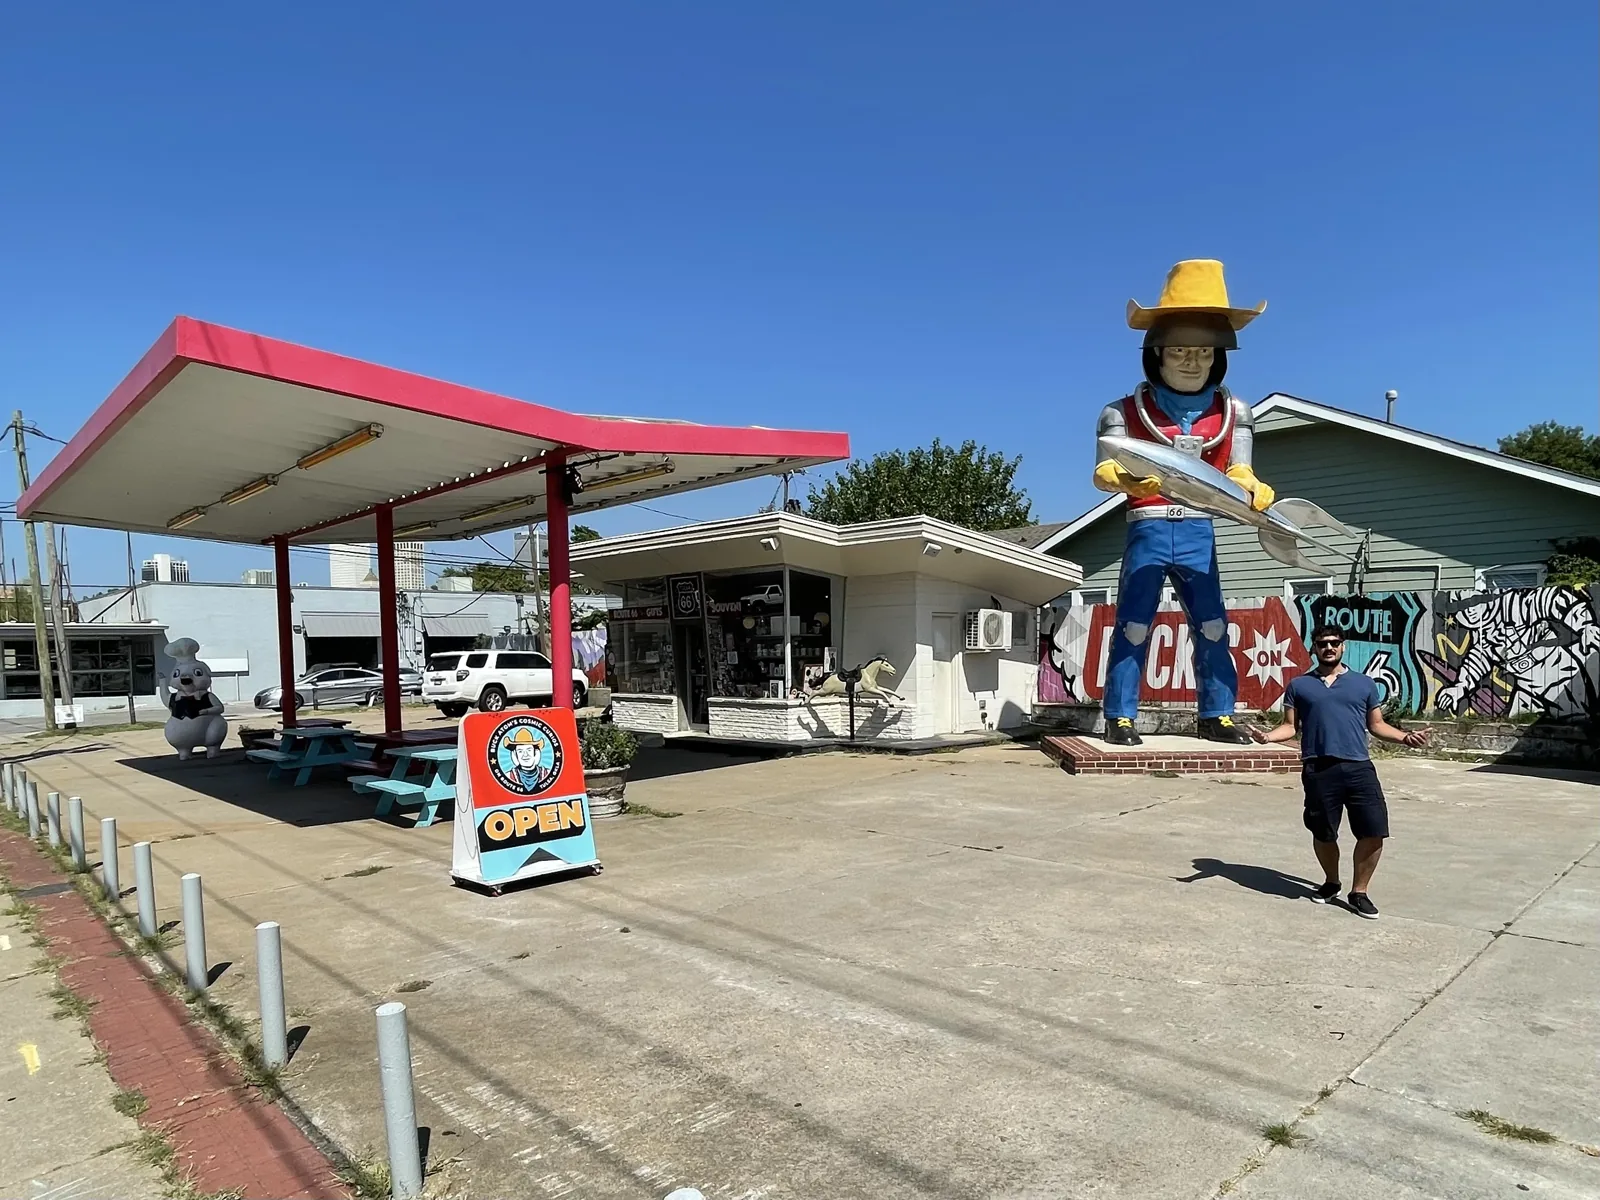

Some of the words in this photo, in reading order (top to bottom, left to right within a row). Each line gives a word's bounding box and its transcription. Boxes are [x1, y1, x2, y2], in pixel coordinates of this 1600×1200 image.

[1169, 508, 1183, 517] 66
[680, 595, 692, 609] 66
[613, 609, 630, 619] ROUTE
[630, 608, 639, 618] 66
[646, 606, 663, 617] GIFTS
[1325, 606, 1393, 637] ROUTE
[1257, 650, 1281, 667] ON
[490, 735, 500, 753] BUCK
[498, 719, 518, 736] ATOM'S
[518, 718, 543, 728] COSMIC
[542, 726, 559, 747] CURIOS
[552, 761, 561, 776] OKLA
[494, 768, 502, 777] ON
[500, 776, 516, 791] ROUTE
[484, 799, 585, 841] OPEN
